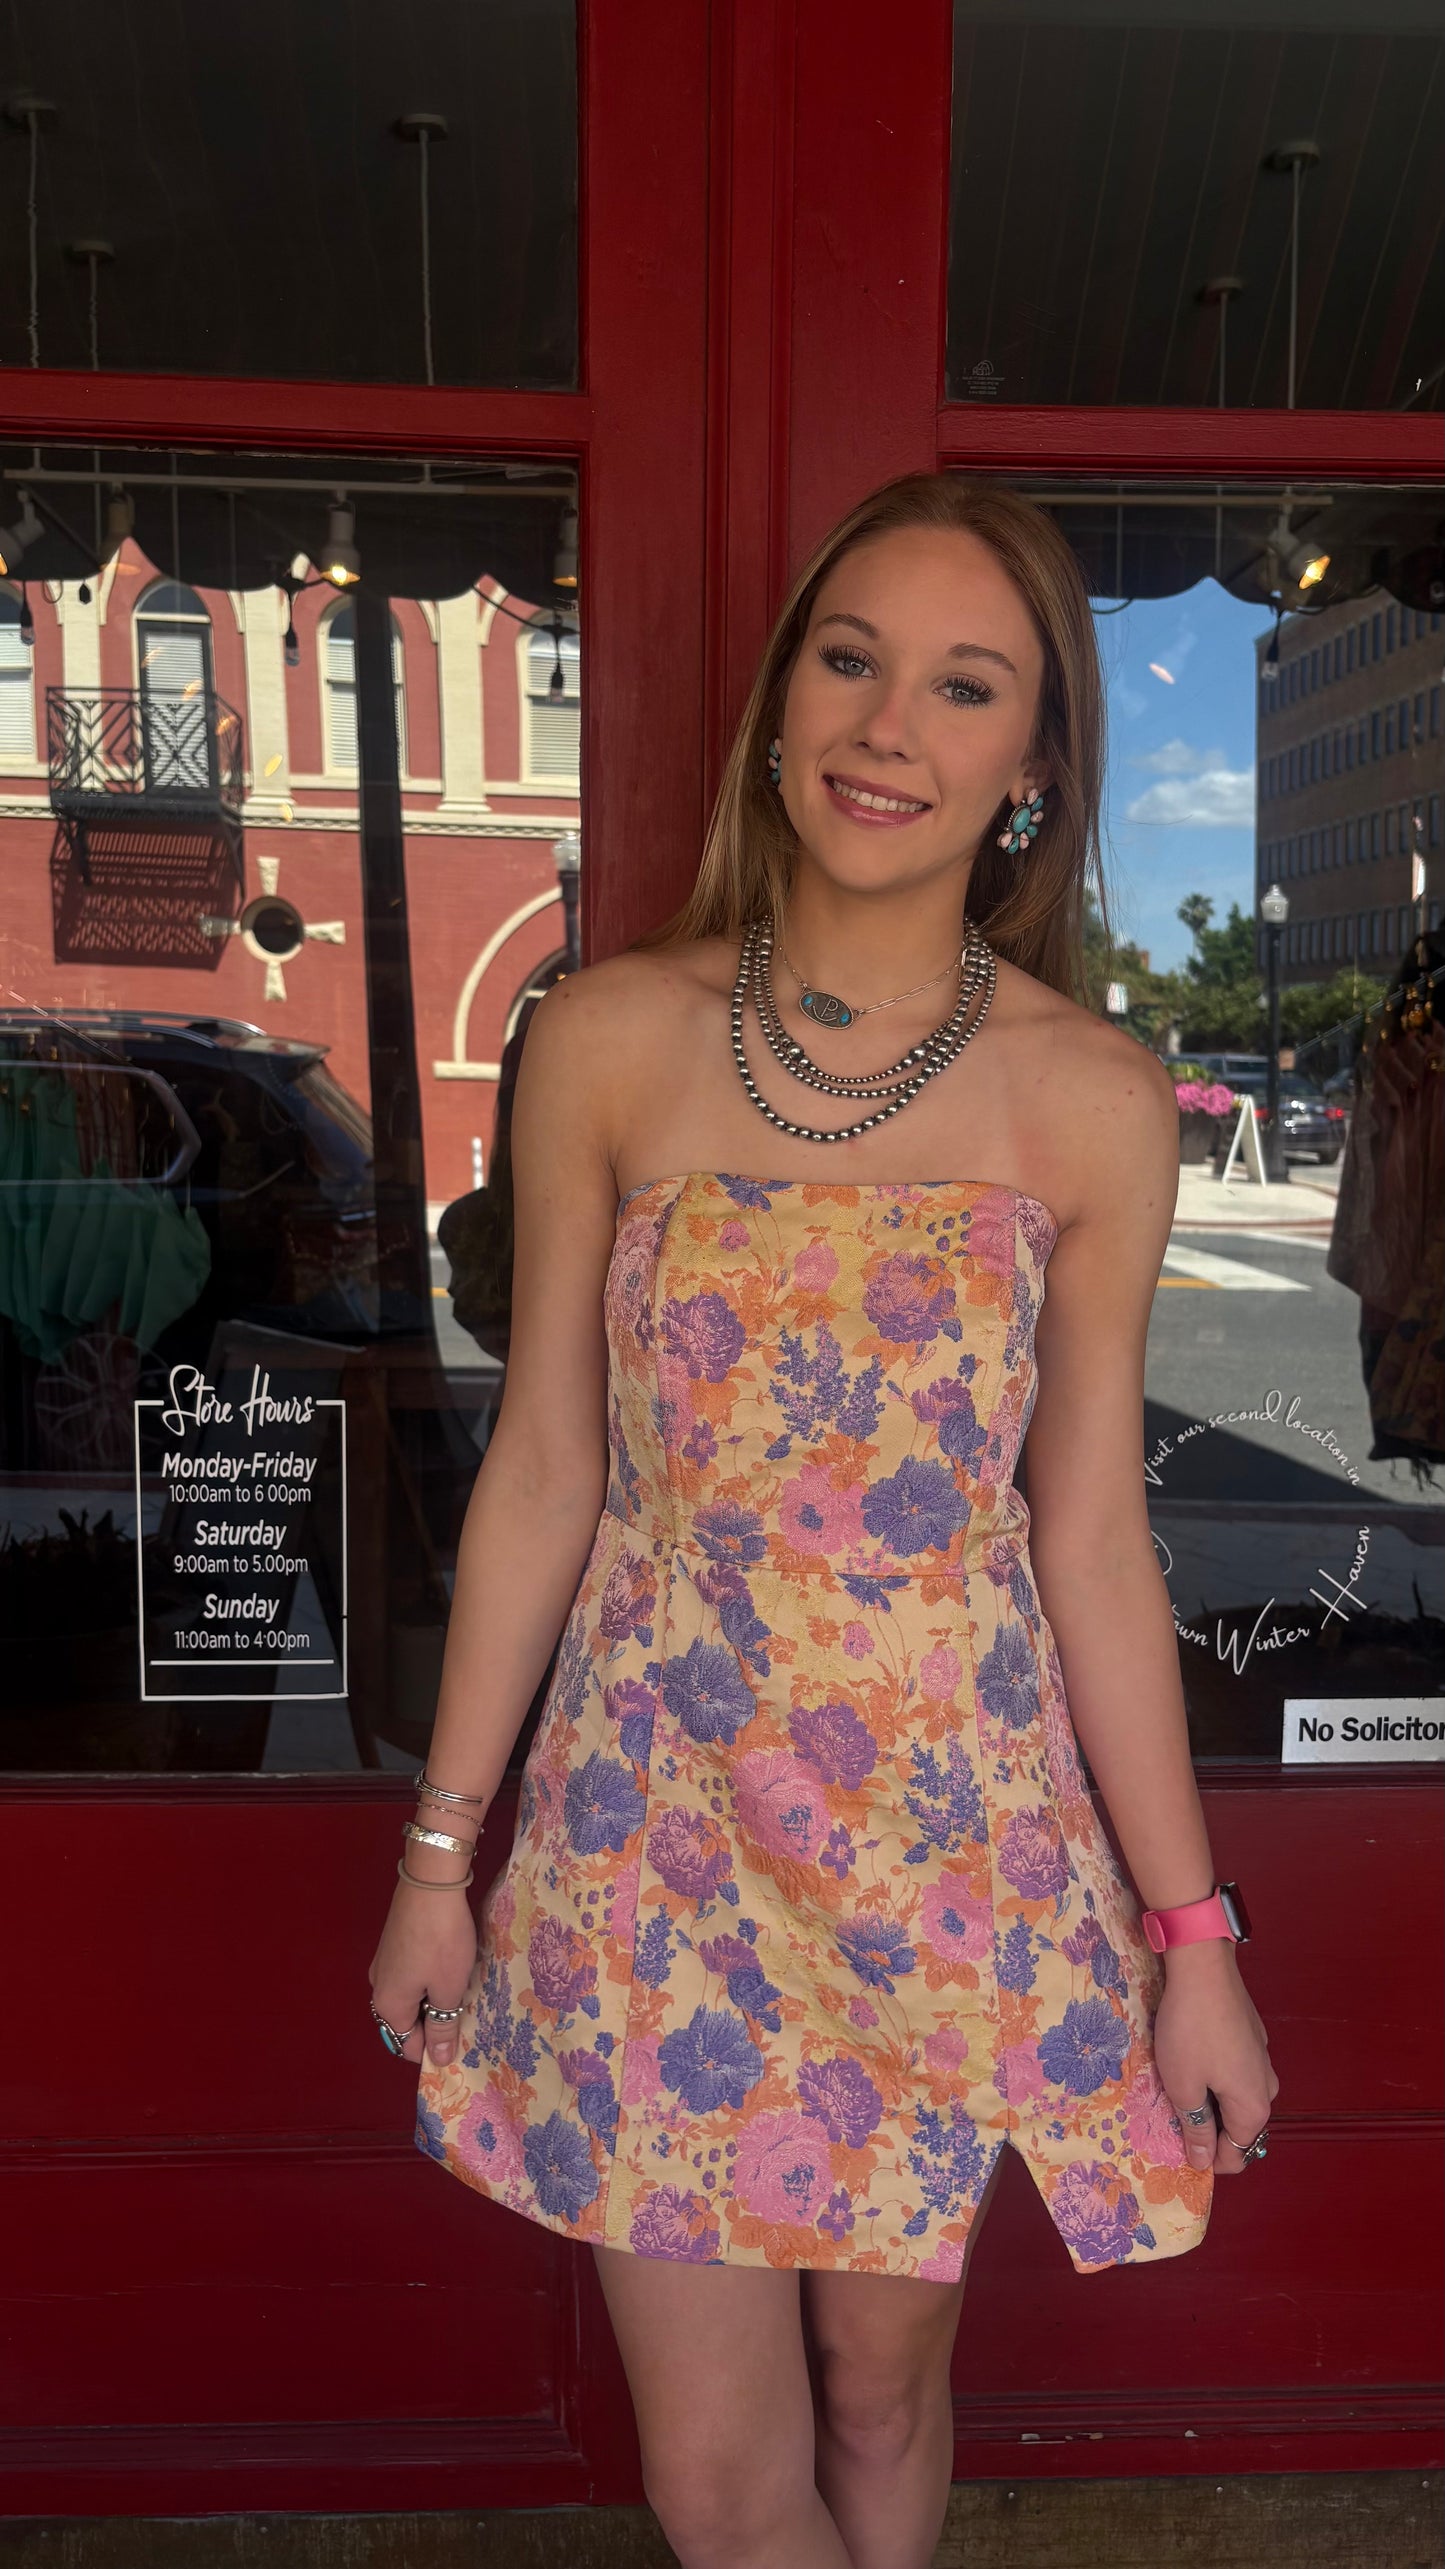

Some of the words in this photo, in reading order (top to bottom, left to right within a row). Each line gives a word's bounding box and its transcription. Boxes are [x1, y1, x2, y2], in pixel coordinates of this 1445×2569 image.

[162, 1364, 234, 1437] Store
[239, 1364, 315, 1437] Hours
[1144, 1436, 1174, 1486] Visit
[1177, 1423, 1206, 1443] our
[1208, 1389, 1282, 1428] second
[1285, 1396, 1349, 1466] location
[1346, 1465, 1361, 1486] in
[161, 1451, 318, 1483] Monday-Friday
[169, 1484, 231, 1502] 10:00am
[235, 1484, 251, 1502] to
[194, 1519, 287, 1550] Saturday
[174, 1554, 230, 1573] 9:00am
[233, 1555, 249, 1573] to
[202, 1592, 280, 1623] Sunday
[1216, 1597, 1310, 1676] Winter
[1309, 1525, 1370, 1631] Haven
[174, 1630, 231, 1648] 11:00am
[234, 1630, 250, 1648] to
[1298, 1717, 1334, 1742] No
